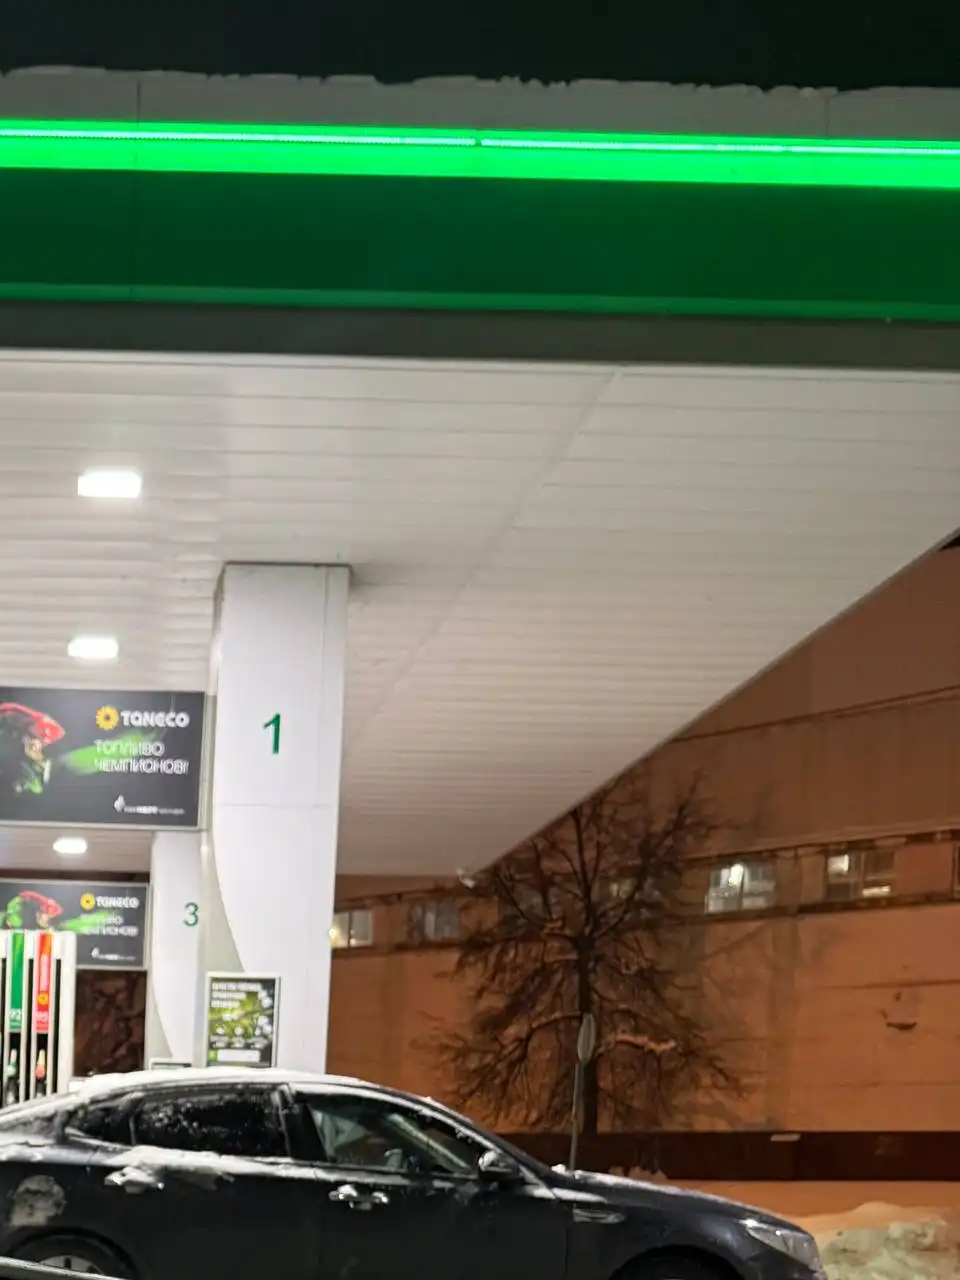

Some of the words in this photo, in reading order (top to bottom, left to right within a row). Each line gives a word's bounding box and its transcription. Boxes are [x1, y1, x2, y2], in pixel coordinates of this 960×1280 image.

[263, 713, 282, 755] 1
[93, 739, 165, 757] ТОПЛИВО
[183, 902, 199, 927] 3
